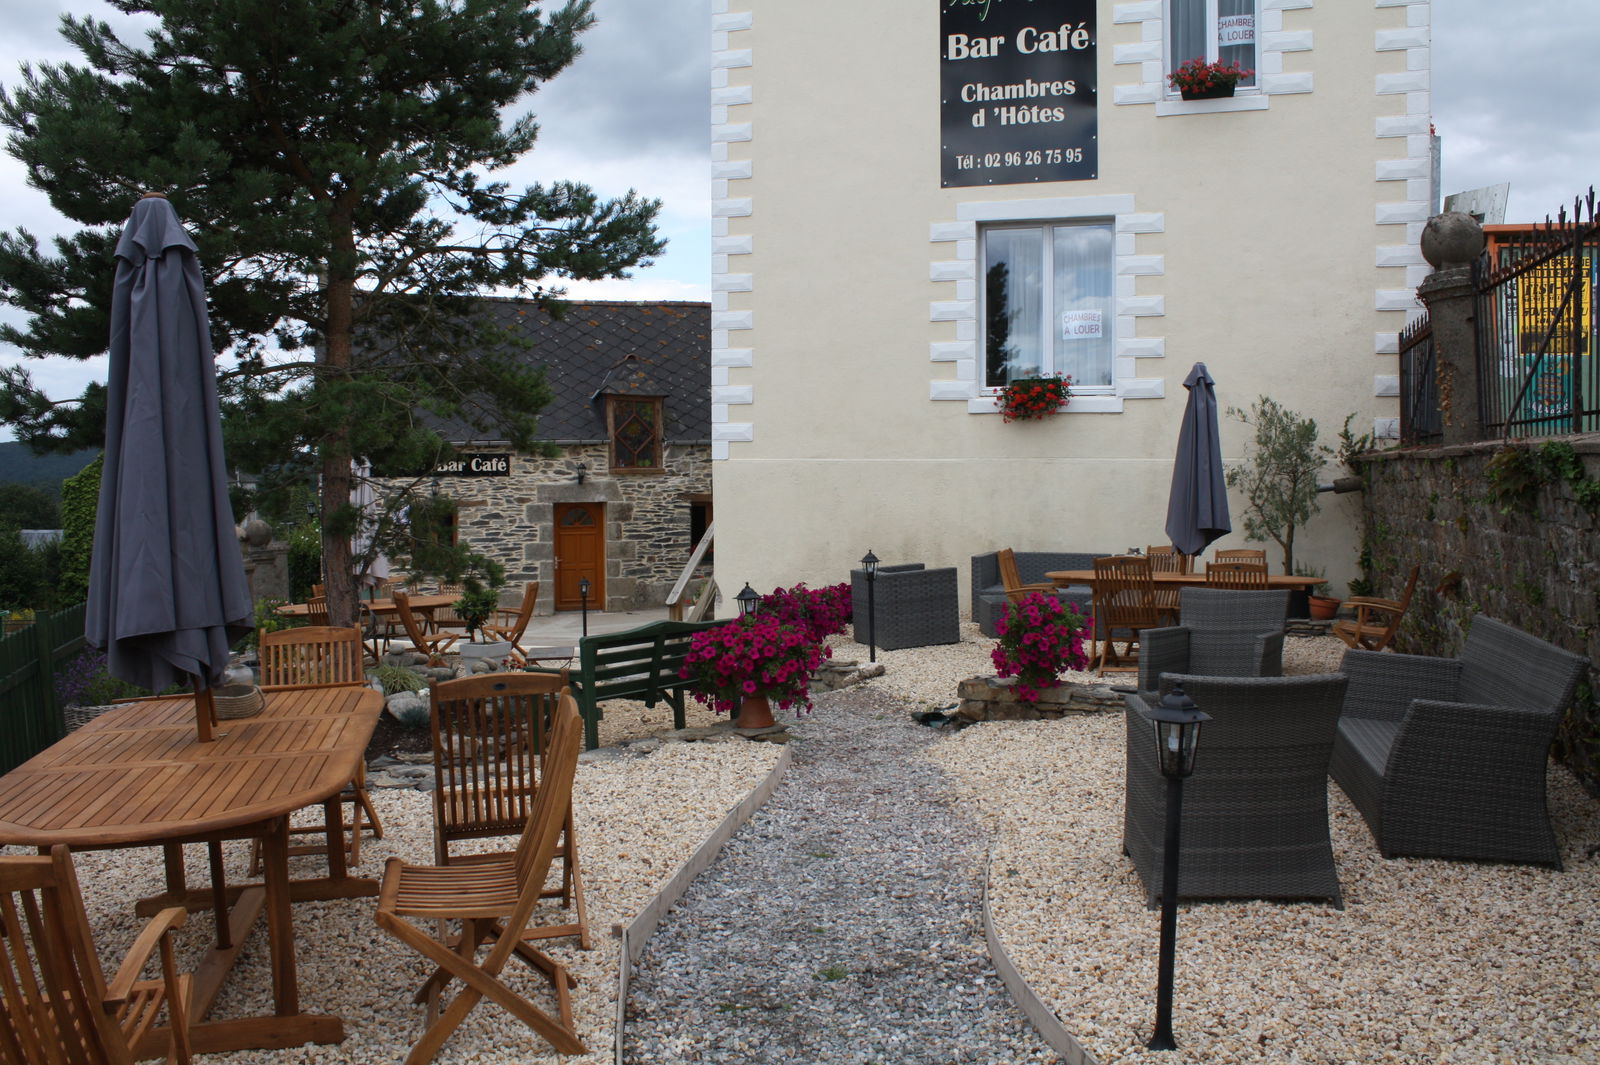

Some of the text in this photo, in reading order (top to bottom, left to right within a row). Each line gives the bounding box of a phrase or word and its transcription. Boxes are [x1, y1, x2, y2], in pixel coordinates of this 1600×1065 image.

[948, 22, 1089, 60] Bar Café
[1227, 30, 1255, 41] LOUER
[961, 79, 1076, 103] Chambres
[985, 153, 1001, 168] 02
[1005, 152, 1021, 166] 96
[1025, 151, 1041, 165] 26
[1045, 149, 1062, 164] 75
[1066, 148, 1082, 163] 95
[1074, 324, 1100, 335] LOUER
[471, 457, 507, 472] Café
